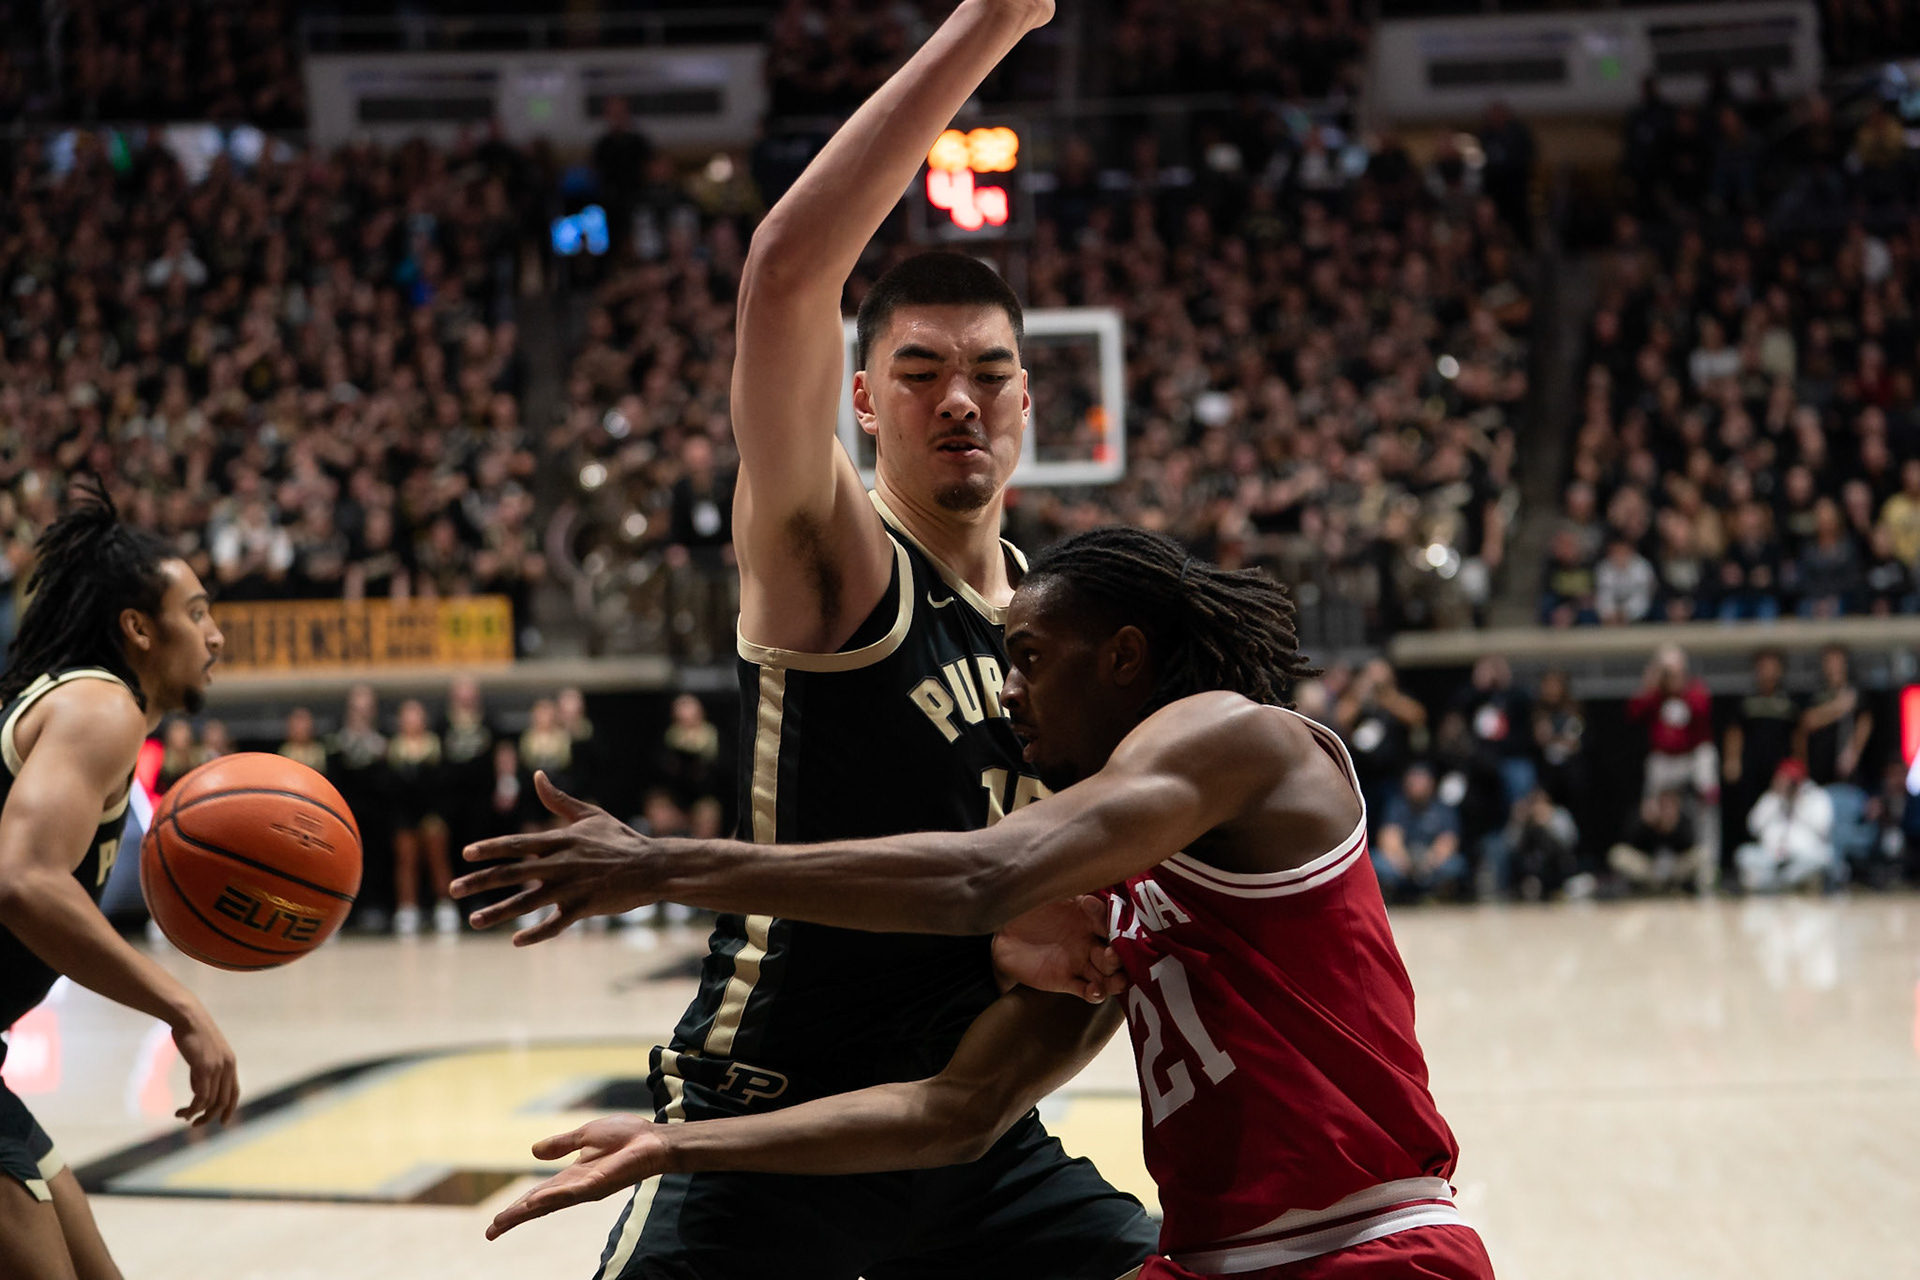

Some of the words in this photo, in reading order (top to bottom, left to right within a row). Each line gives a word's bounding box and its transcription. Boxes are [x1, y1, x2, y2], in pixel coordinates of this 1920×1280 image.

[906, 654, 1011, 743] PUR
[213, 885, 322, 942] ELITE
[1128, 954, 1237, 1128] 21
